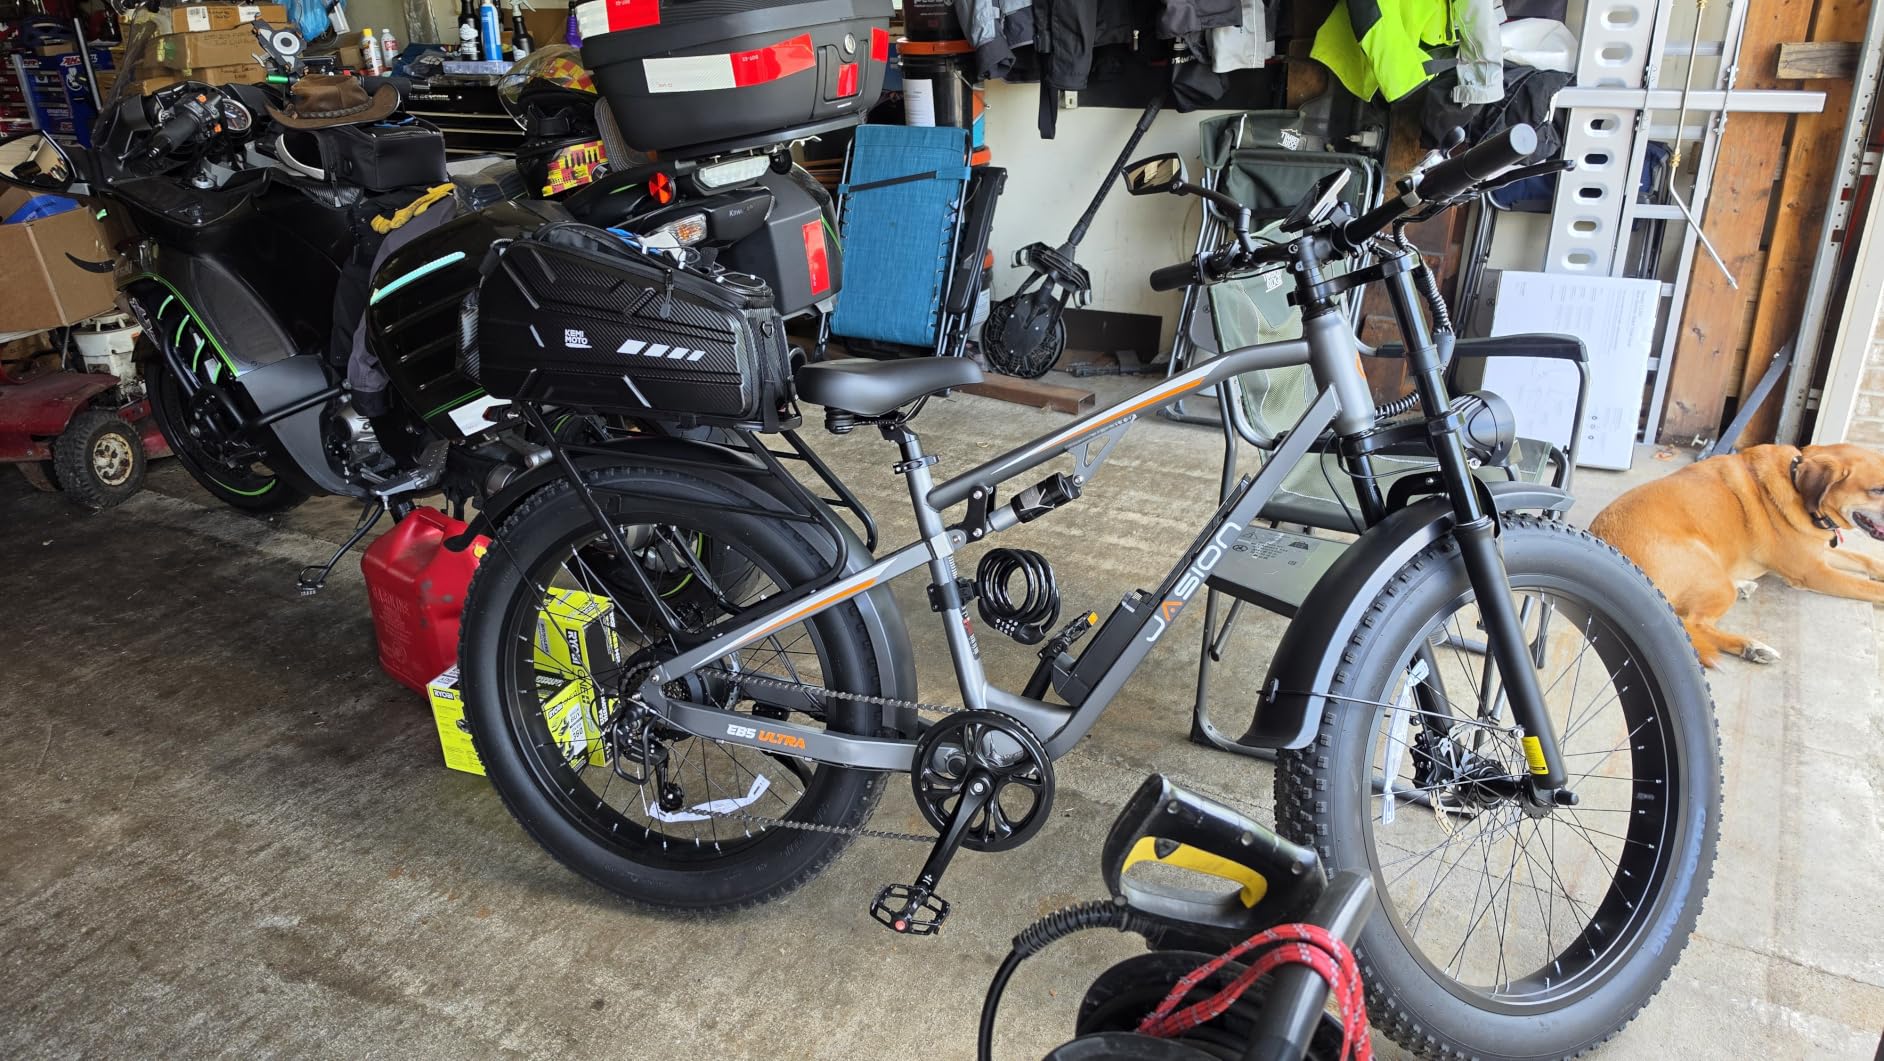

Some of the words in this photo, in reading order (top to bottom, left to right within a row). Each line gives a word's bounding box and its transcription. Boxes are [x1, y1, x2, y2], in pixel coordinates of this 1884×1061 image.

[565, 328, 584, 337] KEMI
[565, 336, 588, 345] MOTO
[1146, 521, 1242, 642] JASION
[567, 630, 582, 666] RYOBI
[726, 724, 757, 739] EB5
[758, 729, 806, 750] ULTRA
